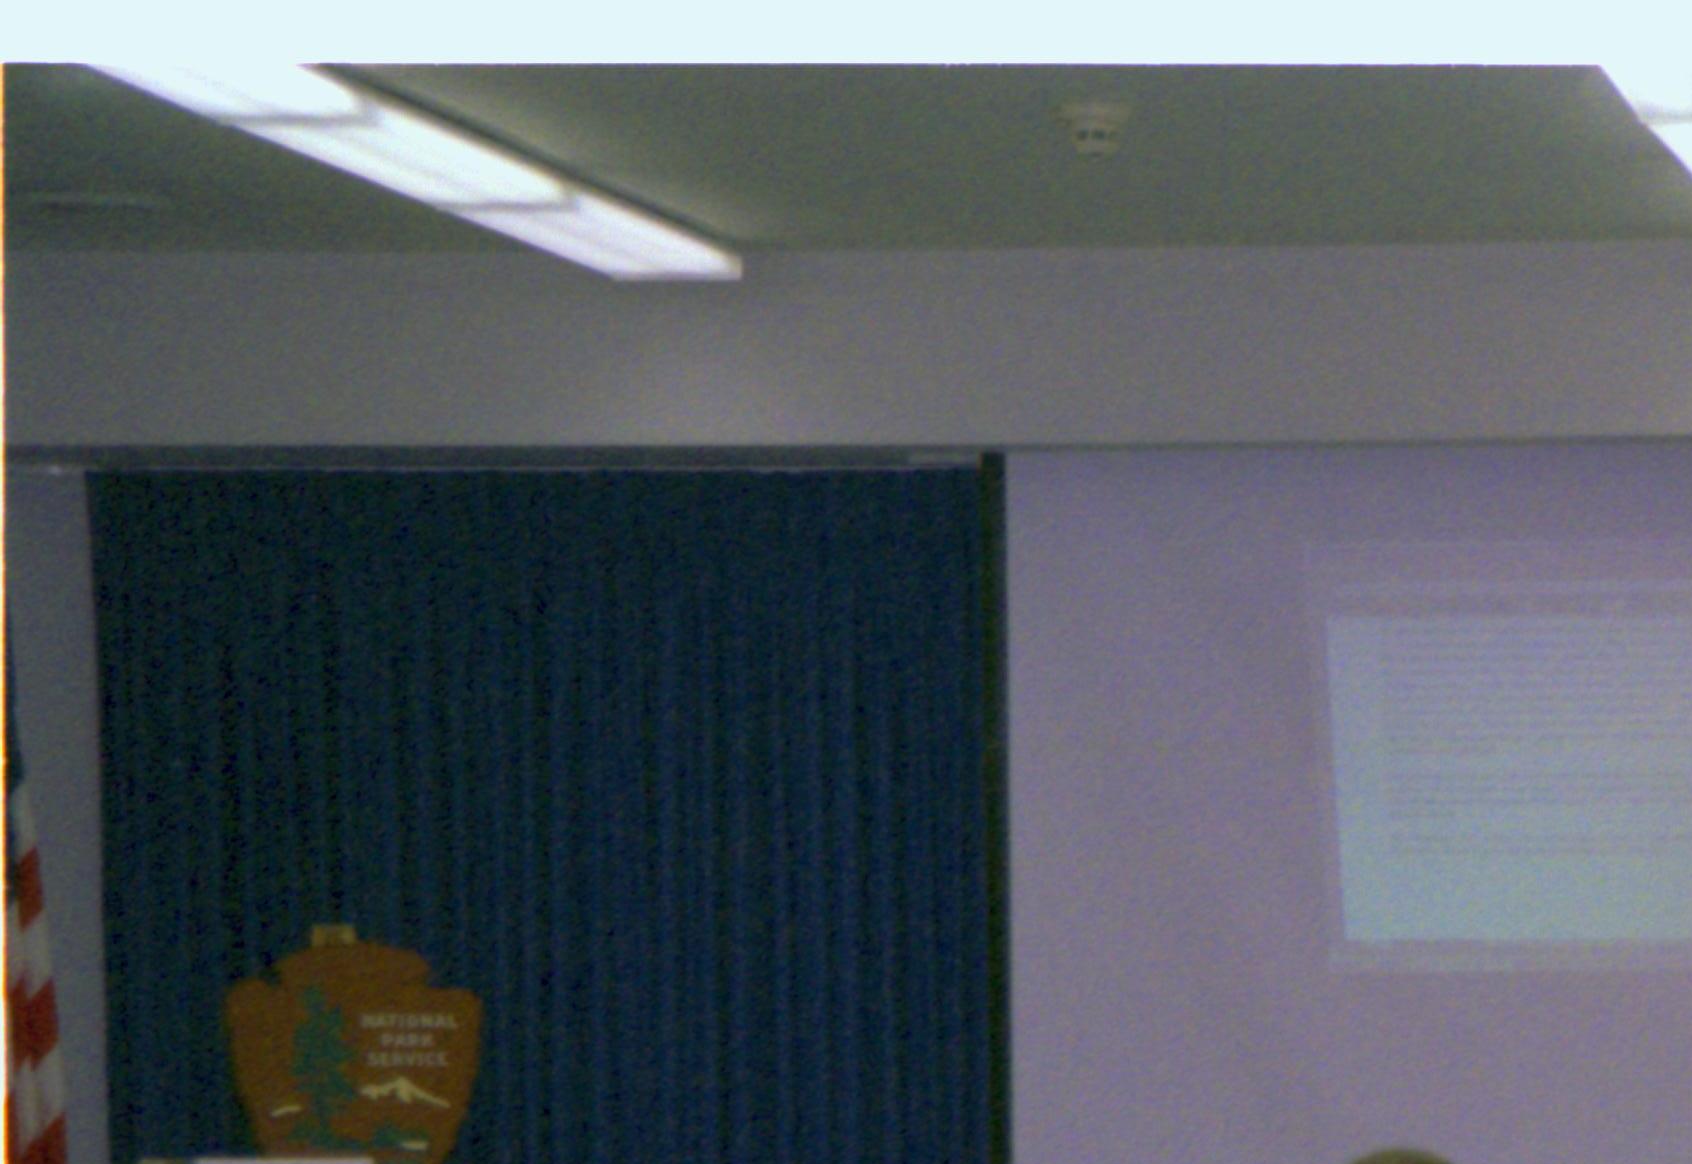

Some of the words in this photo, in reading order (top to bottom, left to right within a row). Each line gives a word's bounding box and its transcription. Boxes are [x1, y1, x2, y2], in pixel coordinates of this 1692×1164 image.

[361, 1013, 458, 1028] NATIONAL
[380, 1033, 435, 1047] PARK
[367, 1052, 448, 1067] SERVICE
